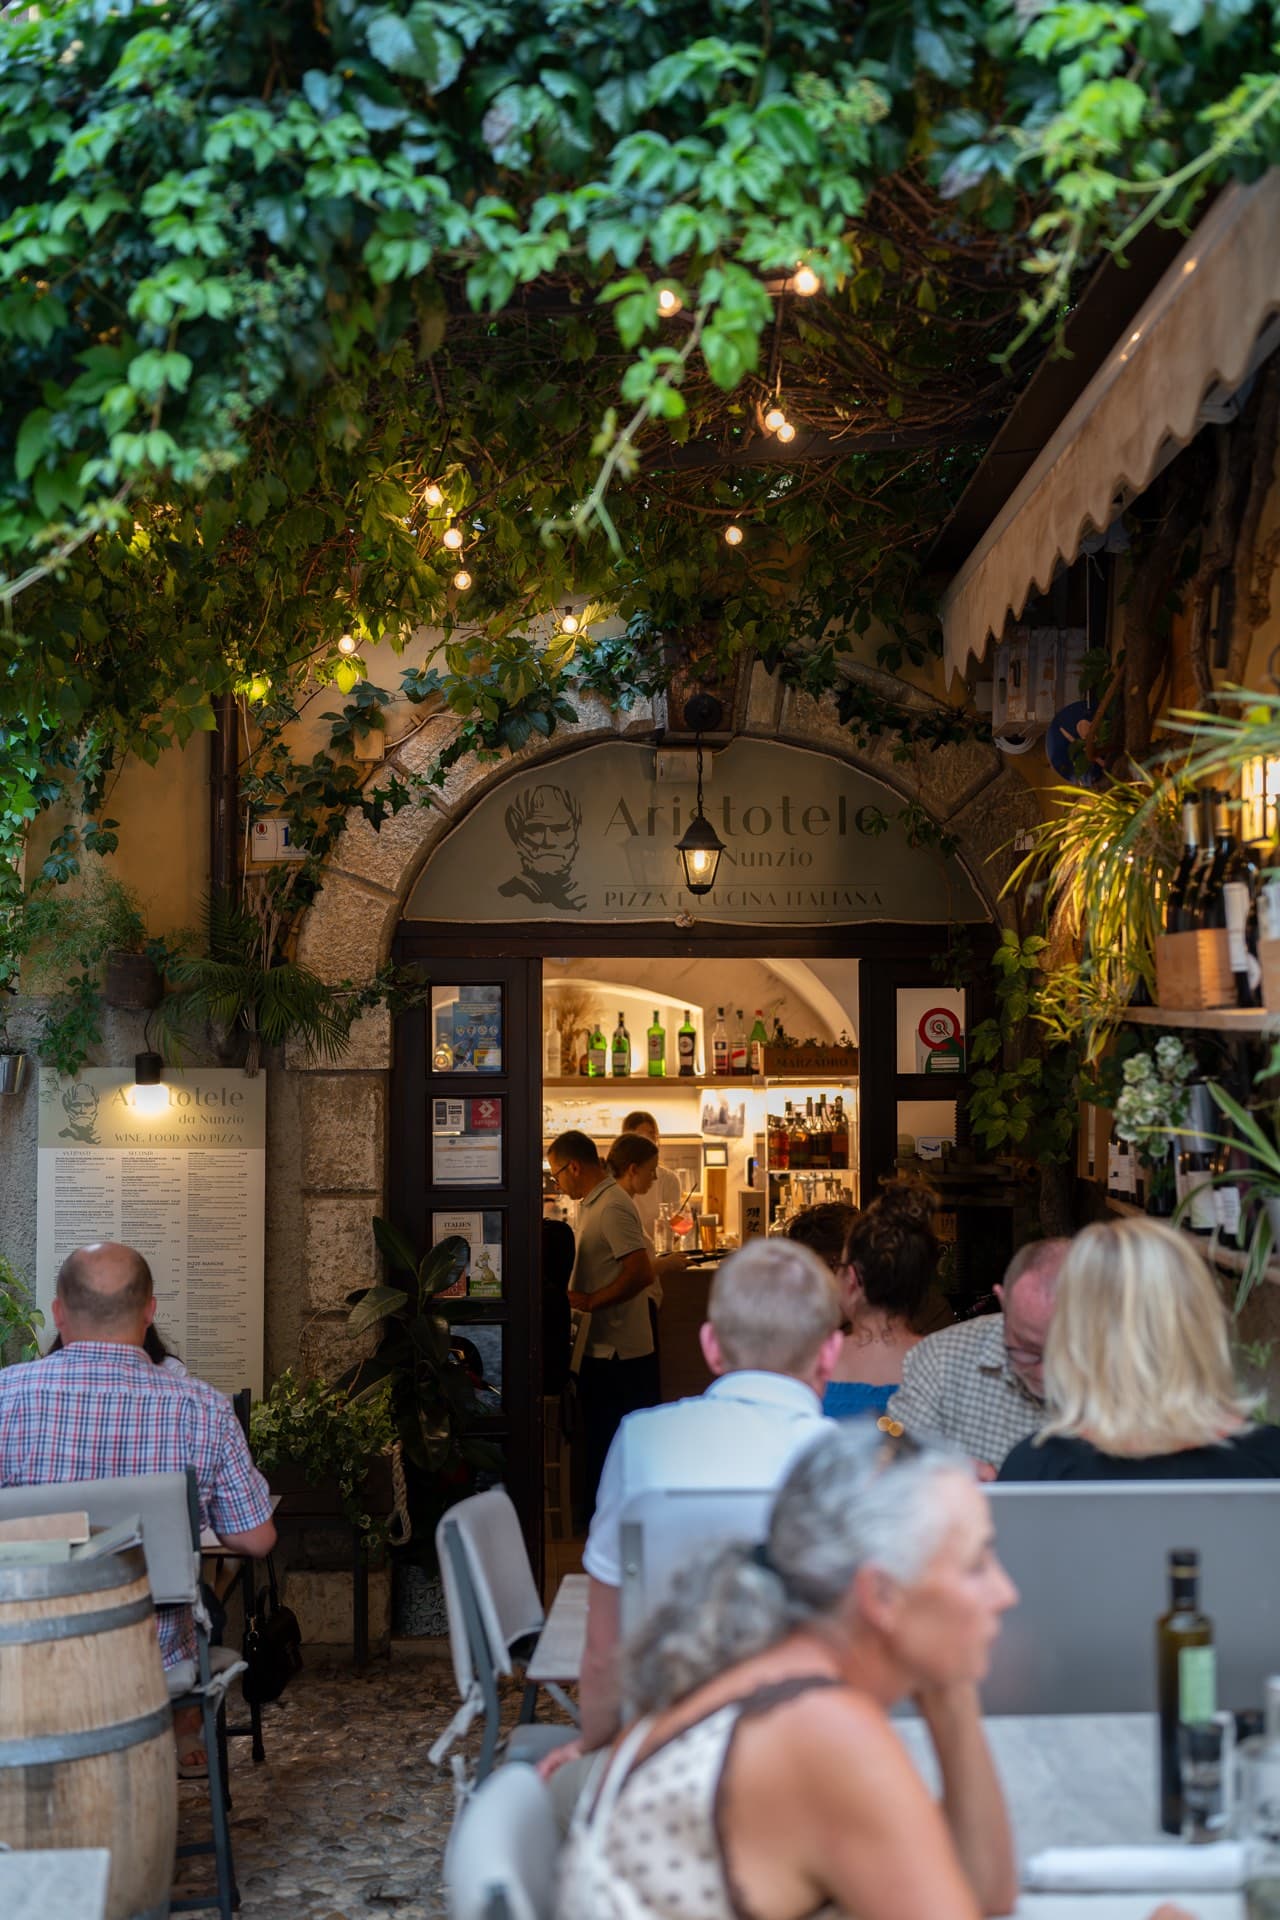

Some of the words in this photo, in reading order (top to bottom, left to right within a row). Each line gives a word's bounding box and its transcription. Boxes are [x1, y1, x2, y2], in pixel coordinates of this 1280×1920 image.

[723, 847, 813, 867] Nunzio
[605, 891, 668, 907] PIZZA
[696, 891, 777, 907] CUCINA
[786, 890, 883, 906] ITALIANA
[112, 1087, 244, 1107] Atotele
[178, 1114, 195, 1125] da
[201, 1115, 244, 1125] Nunzio
[114, 1134, 145, 1143] WINE,
[149, 1134, 179, 1143] FOOD
[184, 1134, 205, 1143] AND
[209, 1134, 243, 1143] PIZZA
